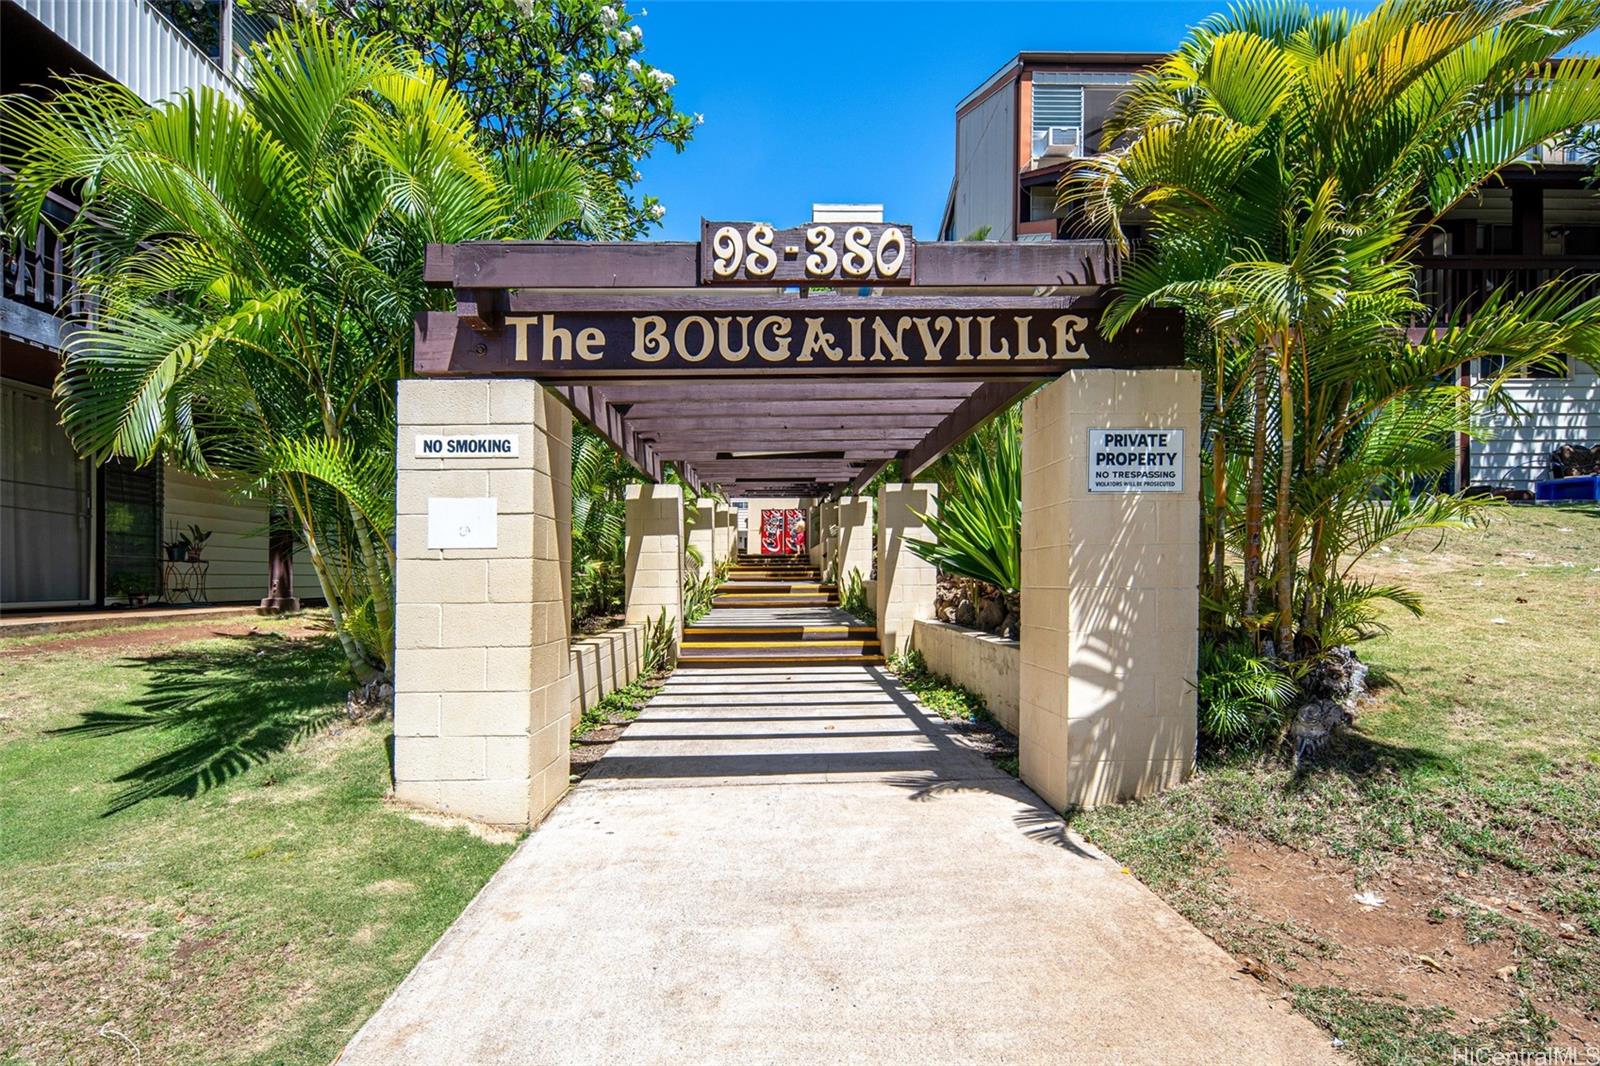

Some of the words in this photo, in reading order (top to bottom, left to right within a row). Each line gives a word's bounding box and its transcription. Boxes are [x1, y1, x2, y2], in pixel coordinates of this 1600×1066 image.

[713, 226, 905, 276] 98-380
[504, 314, 606, 361] The
[631, 315, 1090, 362] BOUGAINVILLE
[423, 440, 442, 453] NO
[447, 439, 511, 453] SMOKING
[1104, 434, 1168, 447] PRIVATE
[1096, 453, 1177, 466] PROPERTY
